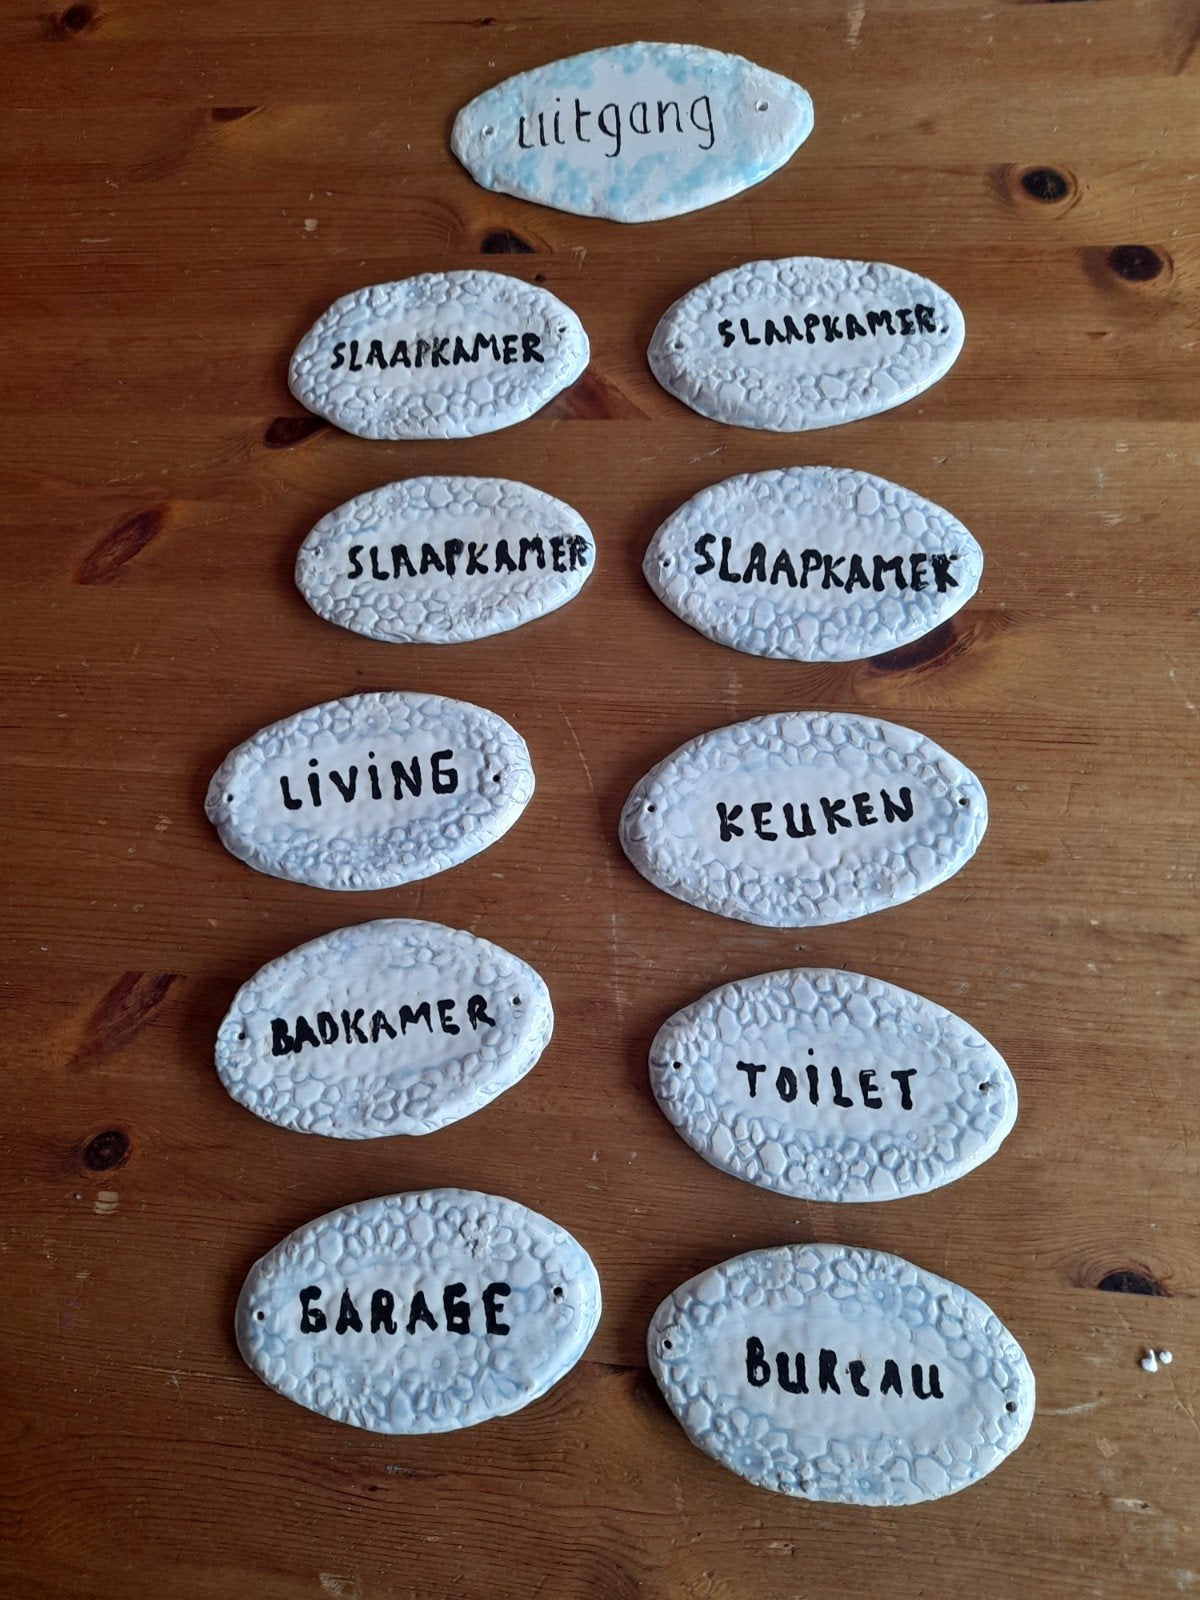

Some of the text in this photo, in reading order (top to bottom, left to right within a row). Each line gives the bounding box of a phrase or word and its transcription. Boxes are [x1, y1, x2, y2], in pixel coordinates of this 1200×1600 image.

[518, 95, 715, 158] uitgang
[330, 332, 545, 373] SLAAPKAMER
[717, 303, 937, 348] SLAAPKAMER
[347, 533, 592, 580] SLAAPKAMER
[694, 532, 959, 594] SLAAPKAMER
[715, 786, 914, 843] KEUKEN
[270, 994, 497, 1057] BADKAMER
[299, 1281, 511, 1336] GARAGE
